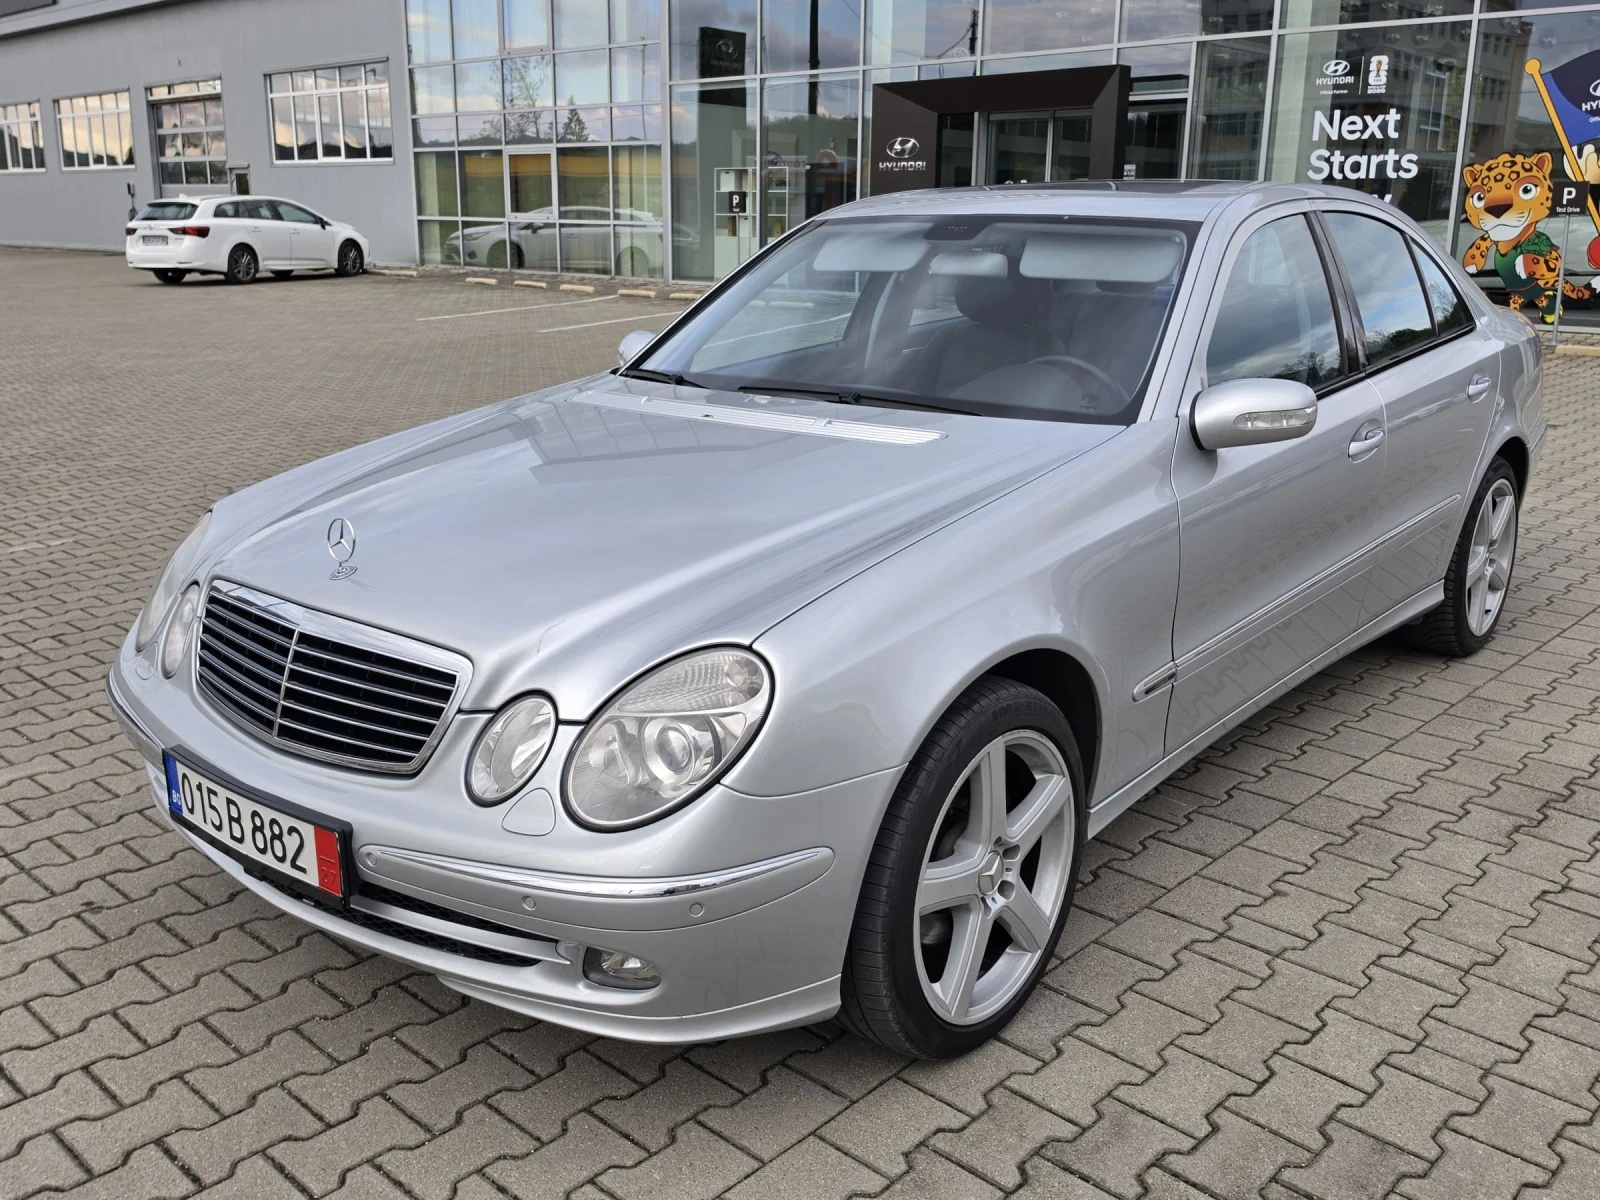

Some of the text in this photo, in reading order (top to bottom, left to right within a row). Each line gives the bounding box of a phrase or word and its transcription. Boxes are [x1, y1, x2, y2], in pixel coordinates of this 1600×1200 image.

[1316, 76, 1354, 85] HYUNDAI
[1312, 107, 1401, 141] Next
[878, 161, 927, 172] HYUNDAI
[1306, 148, 1419, 180] Starts
[732, 195, 739, 207] P
[1562, 187, 1576, 205] P
[171, 789, 182, 806] BG
[320, 866, 336, 885] 27
